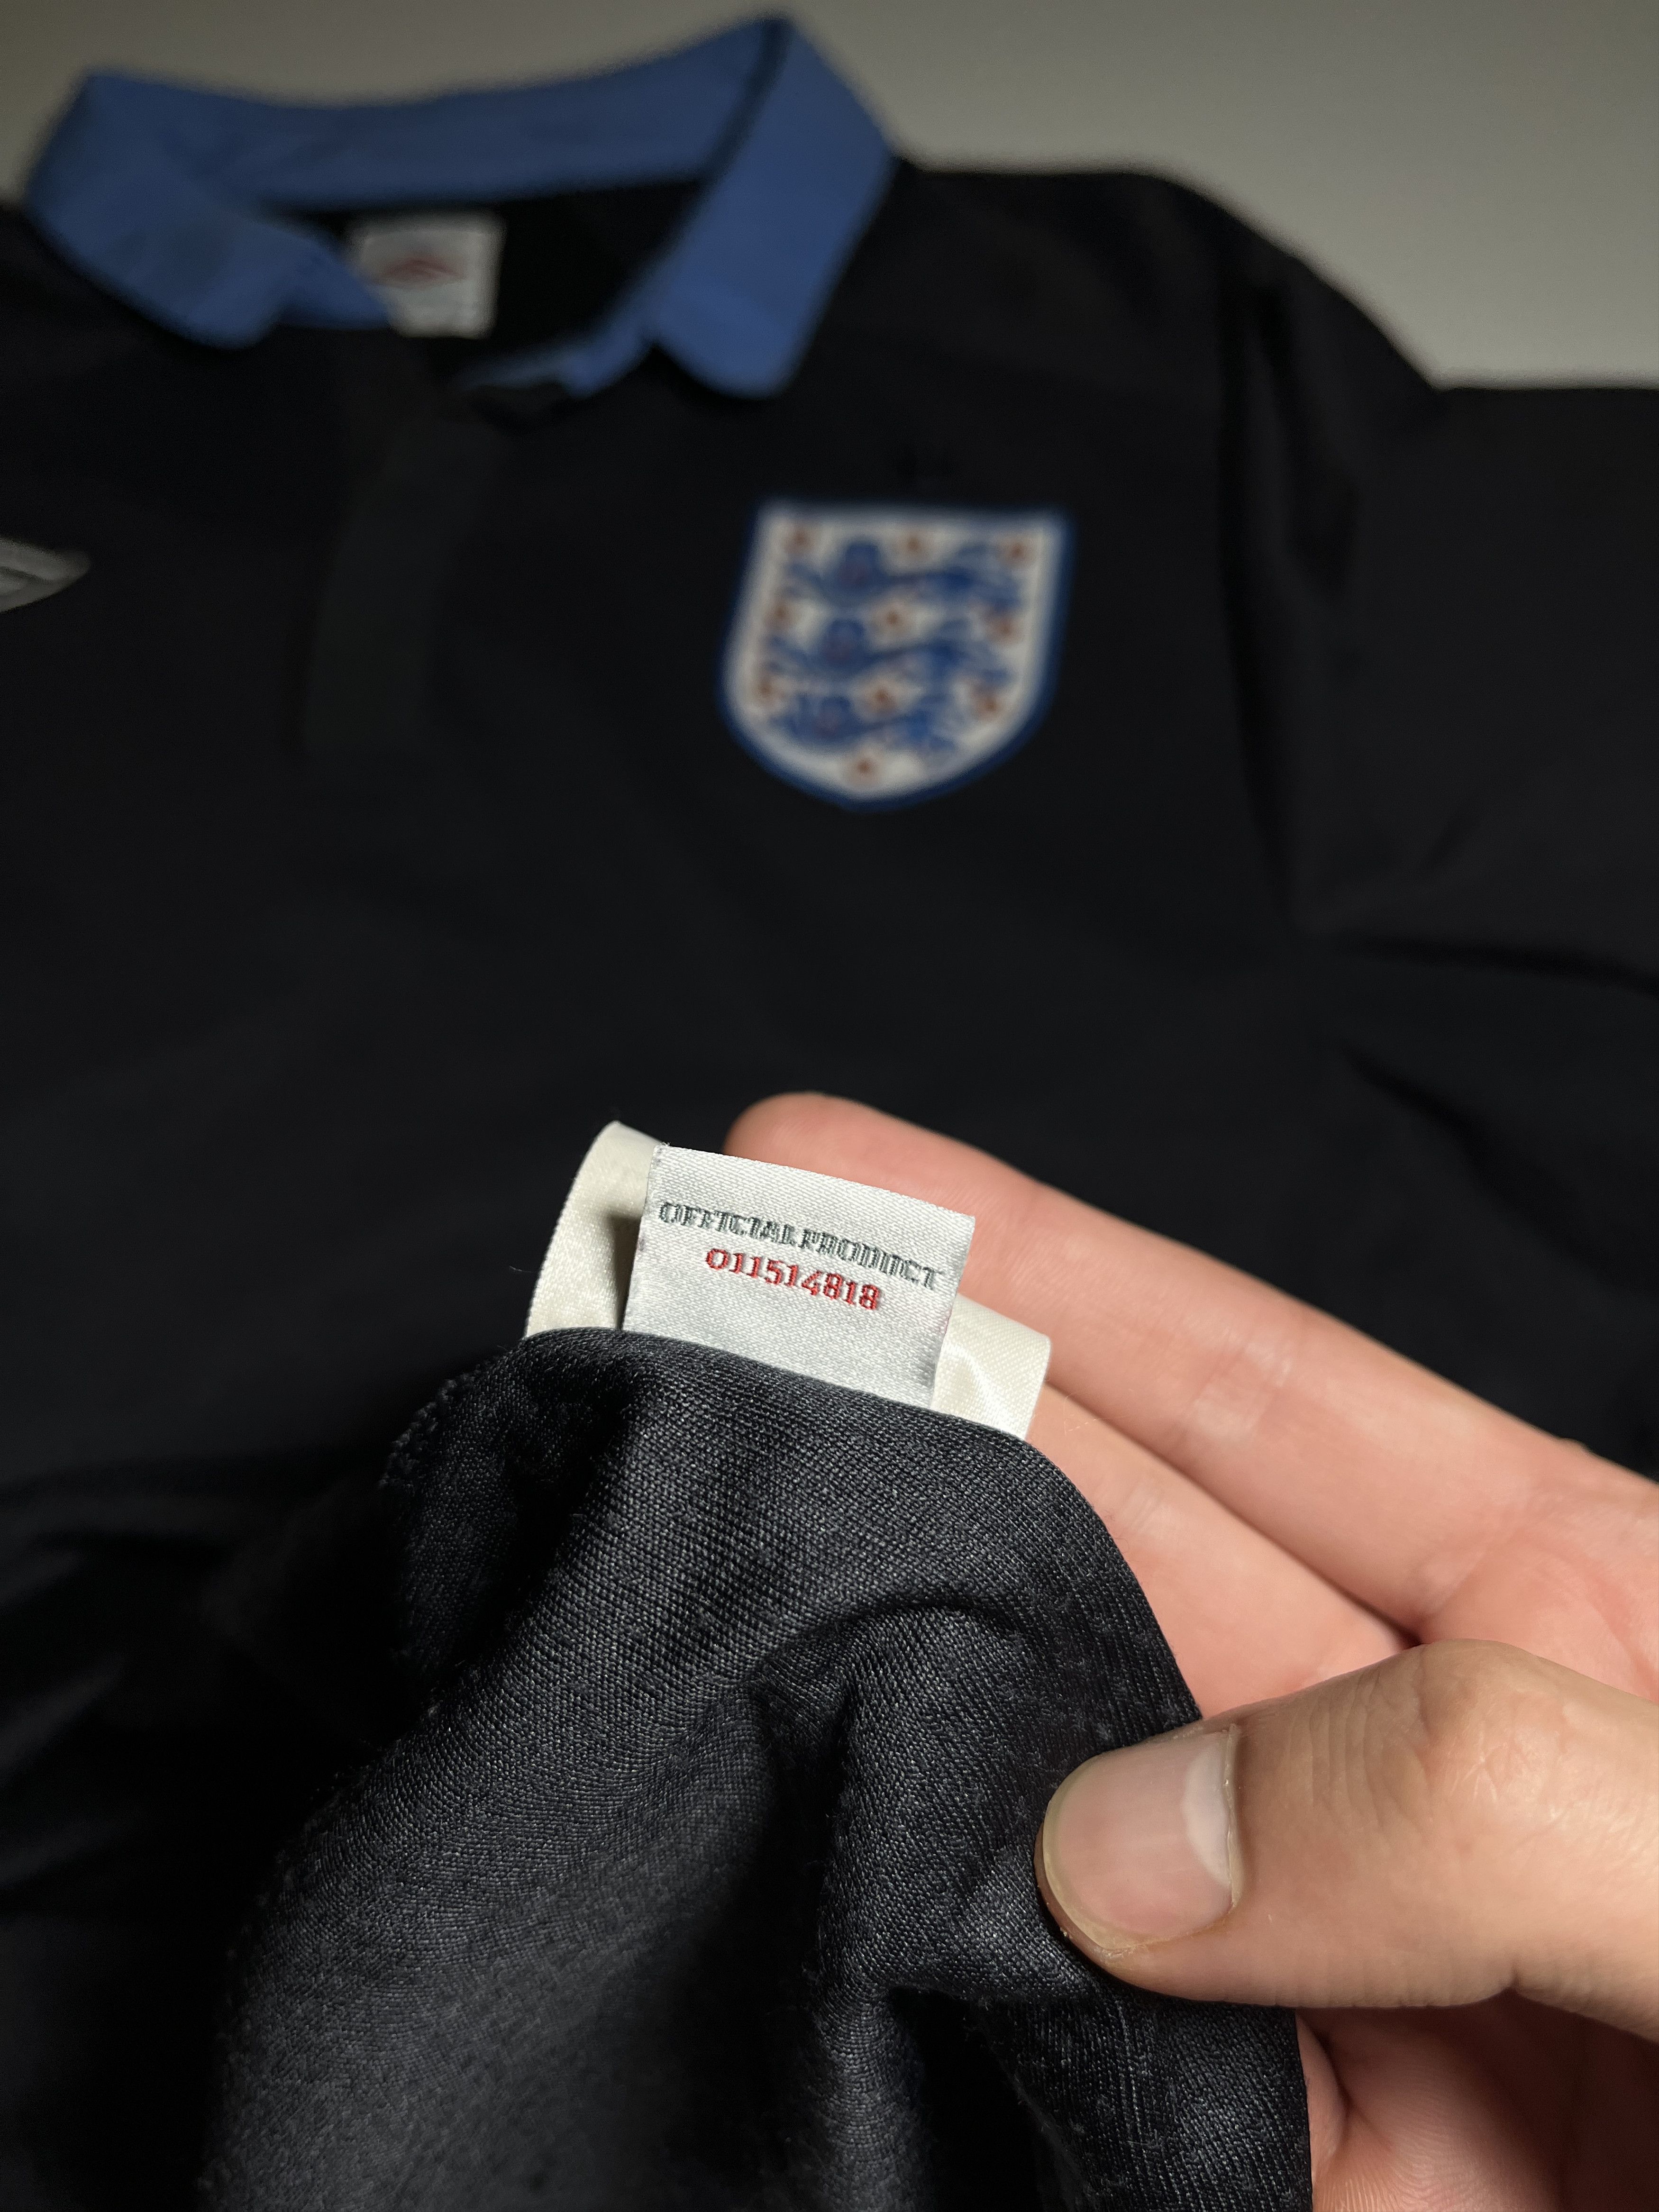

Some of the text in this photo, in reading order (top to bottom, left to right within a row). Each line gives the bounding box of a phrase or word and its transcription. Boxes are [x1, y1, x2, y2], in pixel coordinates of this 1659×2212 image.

[658, 1202, 944, 1290] OFFICIAL PRODUCT
[705, 1248, 880, 1310] 011514818
